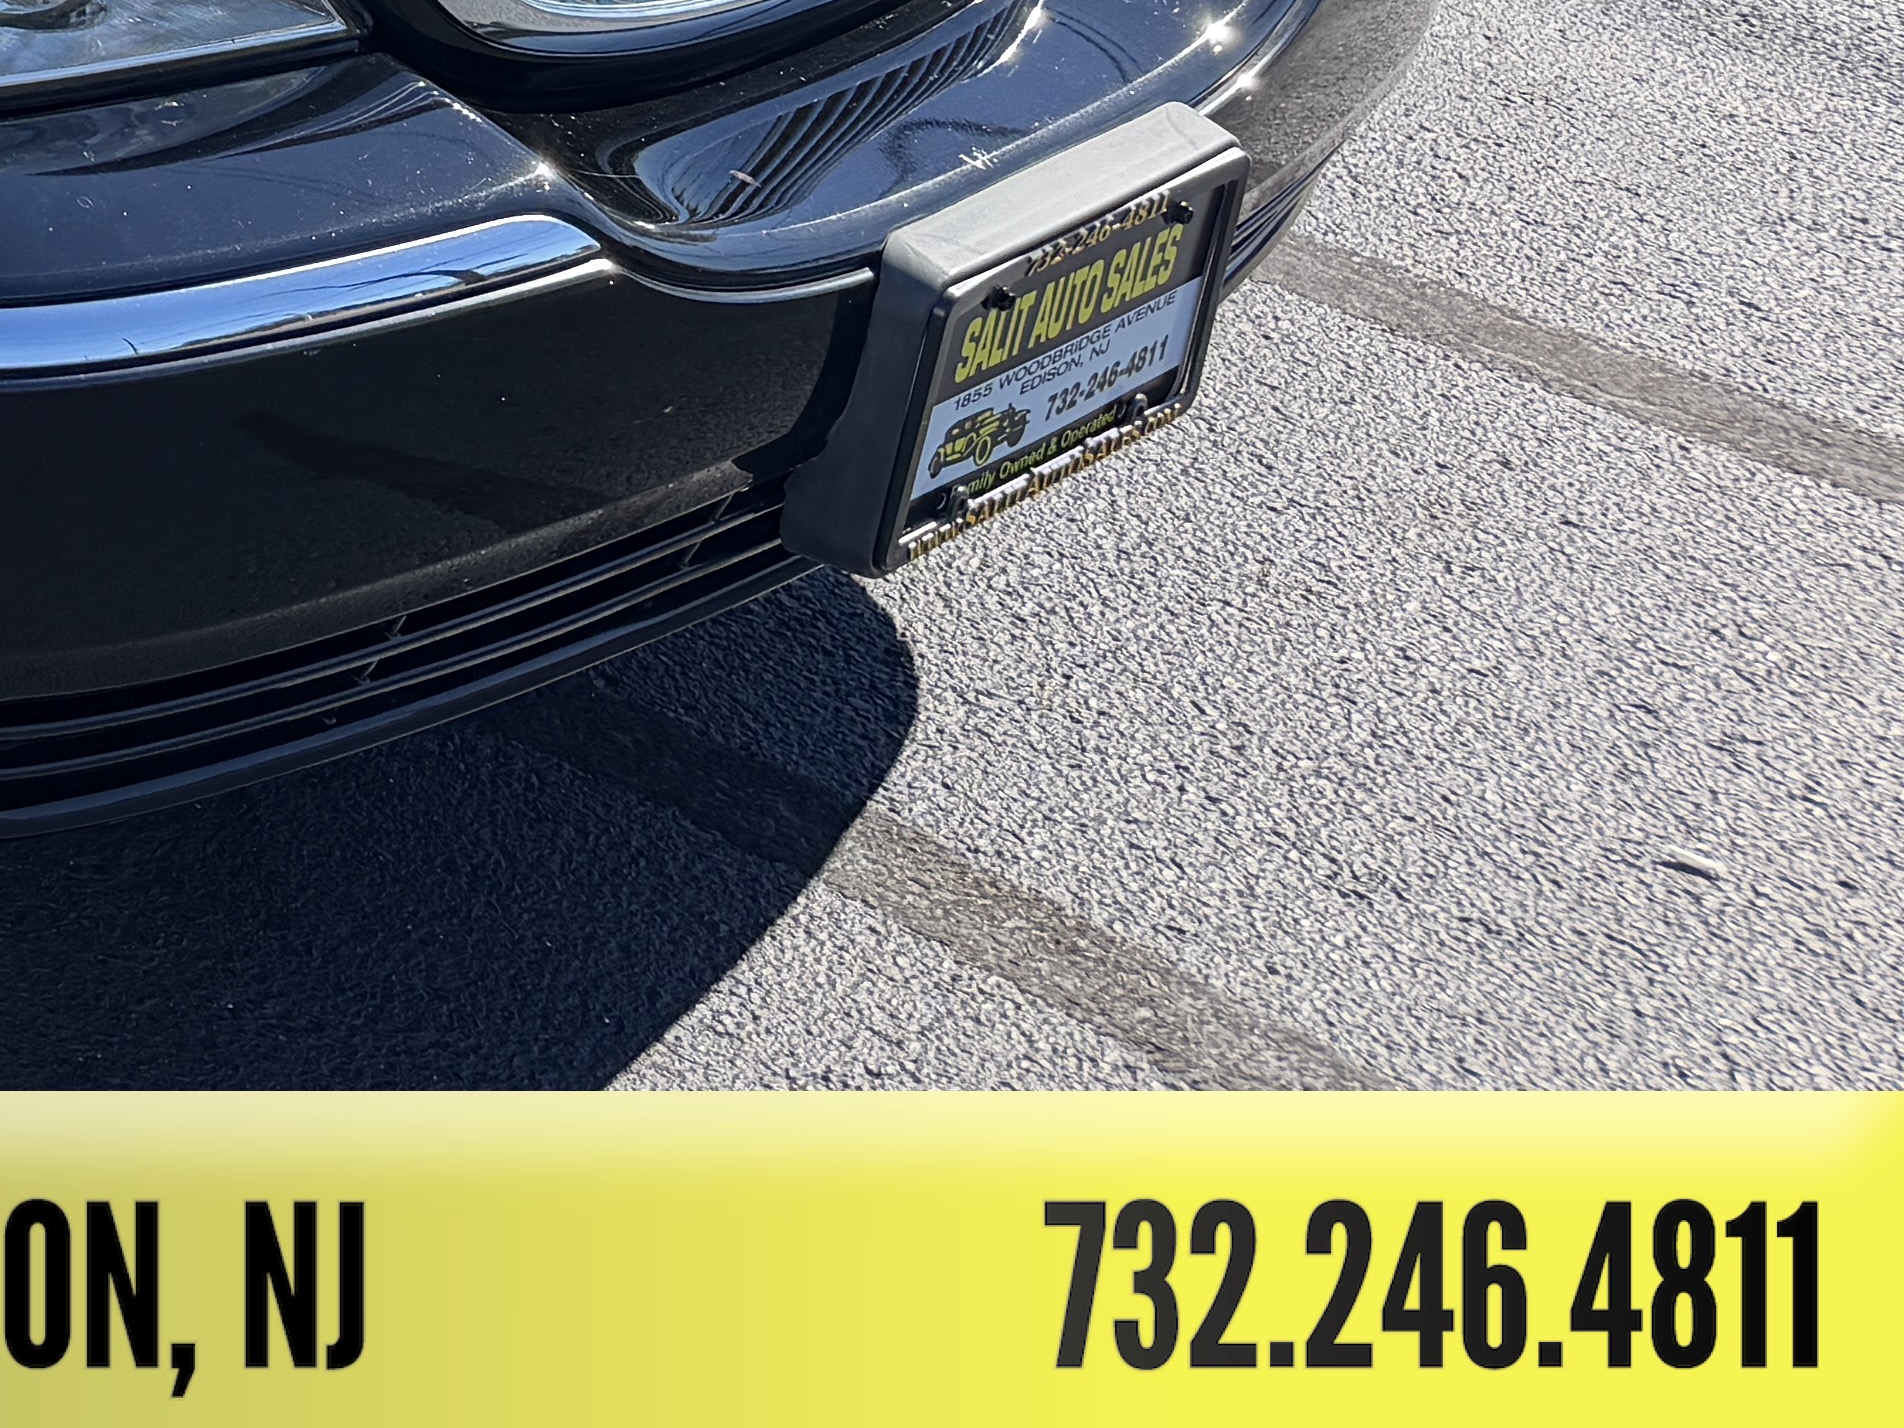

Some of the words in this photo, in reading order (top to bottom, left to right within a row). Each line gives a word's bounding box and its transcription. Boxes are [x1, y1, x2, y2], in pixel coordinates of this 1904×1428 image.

[954, 290, 1037, 384] SALIT
[1027, 259, 1105, 350] AUTO
[1100, 222, 1185, 314] SALES
[954, 383, 993, 412] 1855
[998, 323, 1112, 392] WOODBRIDGE
[1115, 290, 1178, 333] AVENUE
[1019, 355, 1084, 396] EDISON,
[1089, 339, 1112, 360] NJ
[1044, 334, 1170, 422] 732-246-4811
[951, 470, 996, 499] Fmily
[999, 449, 1044, 480] Owned
[1045, 443, 1058, 458] &
[1060, 408, 1117, 448] Operated
